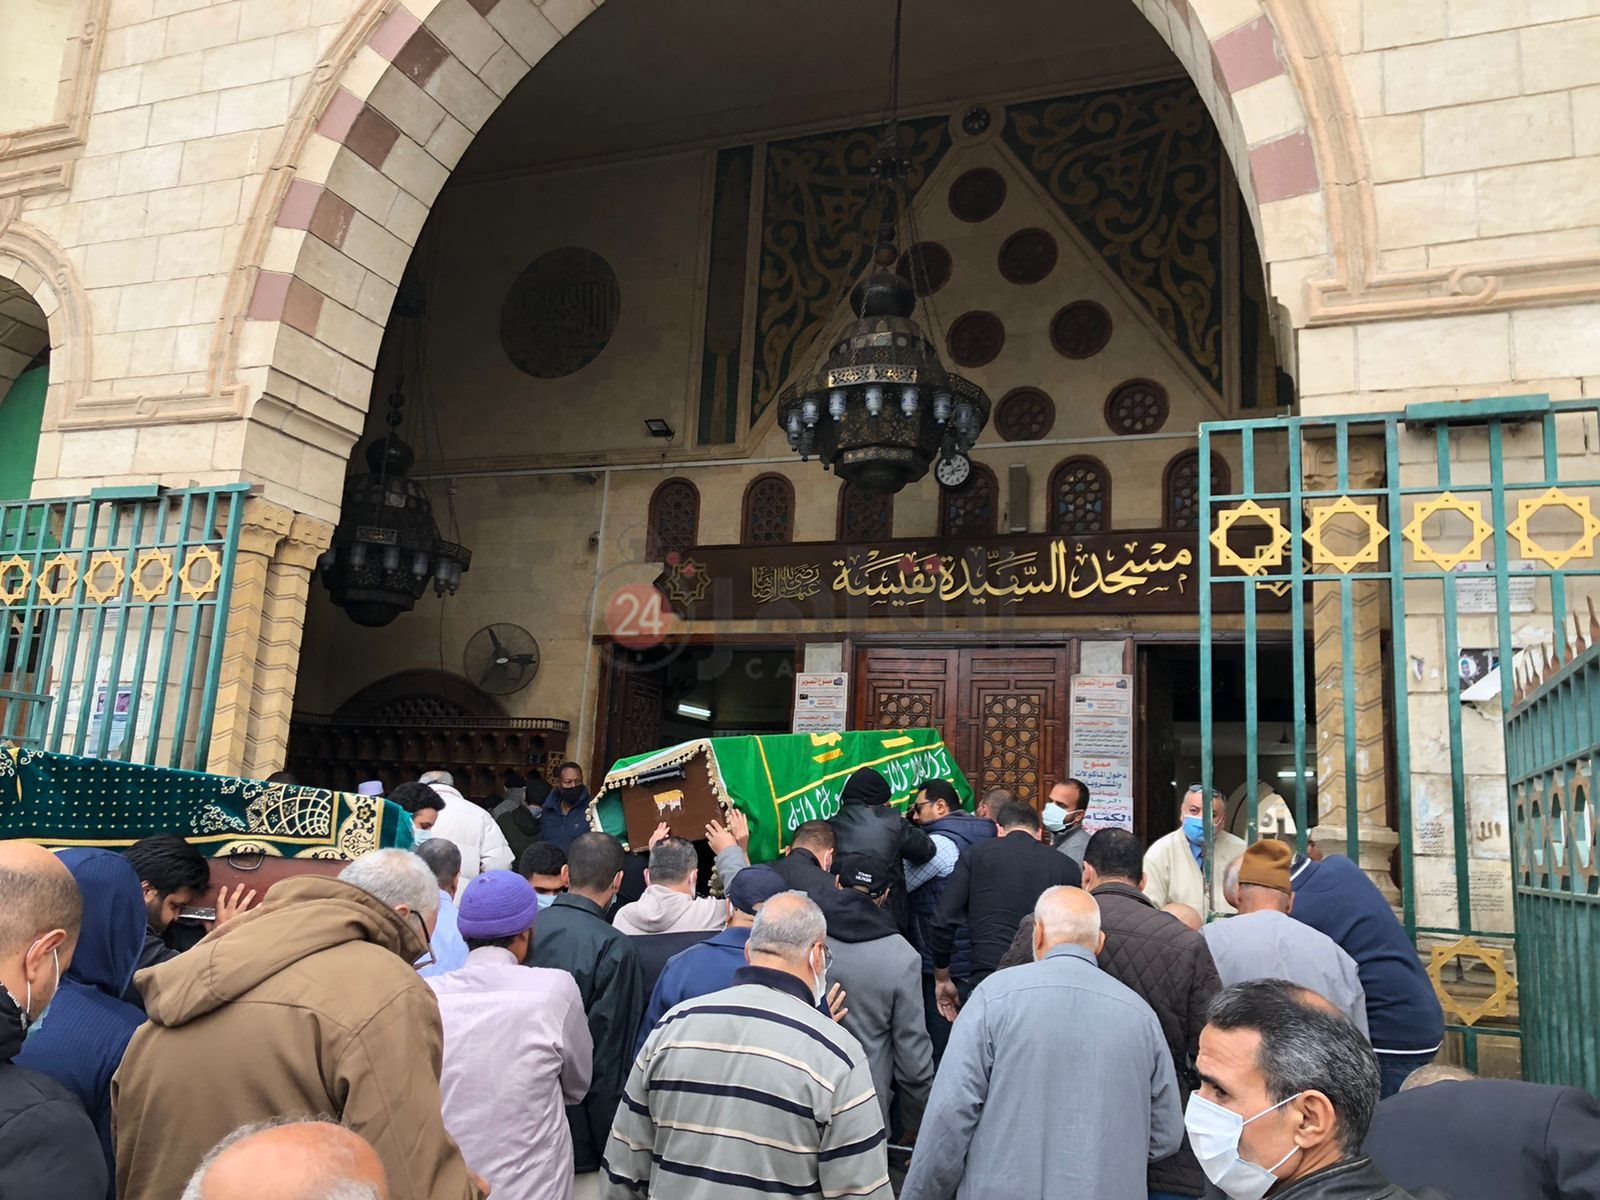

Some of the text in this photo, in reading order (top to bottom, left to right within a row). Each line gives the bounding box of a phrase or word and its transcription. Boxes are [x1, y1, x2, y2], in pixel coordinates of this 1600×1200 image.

[1069, 541, 1193, 598] مسجد
[1083, 760, 1112, 770] ممنوع
[1476, 820, 1502, 842] الله
